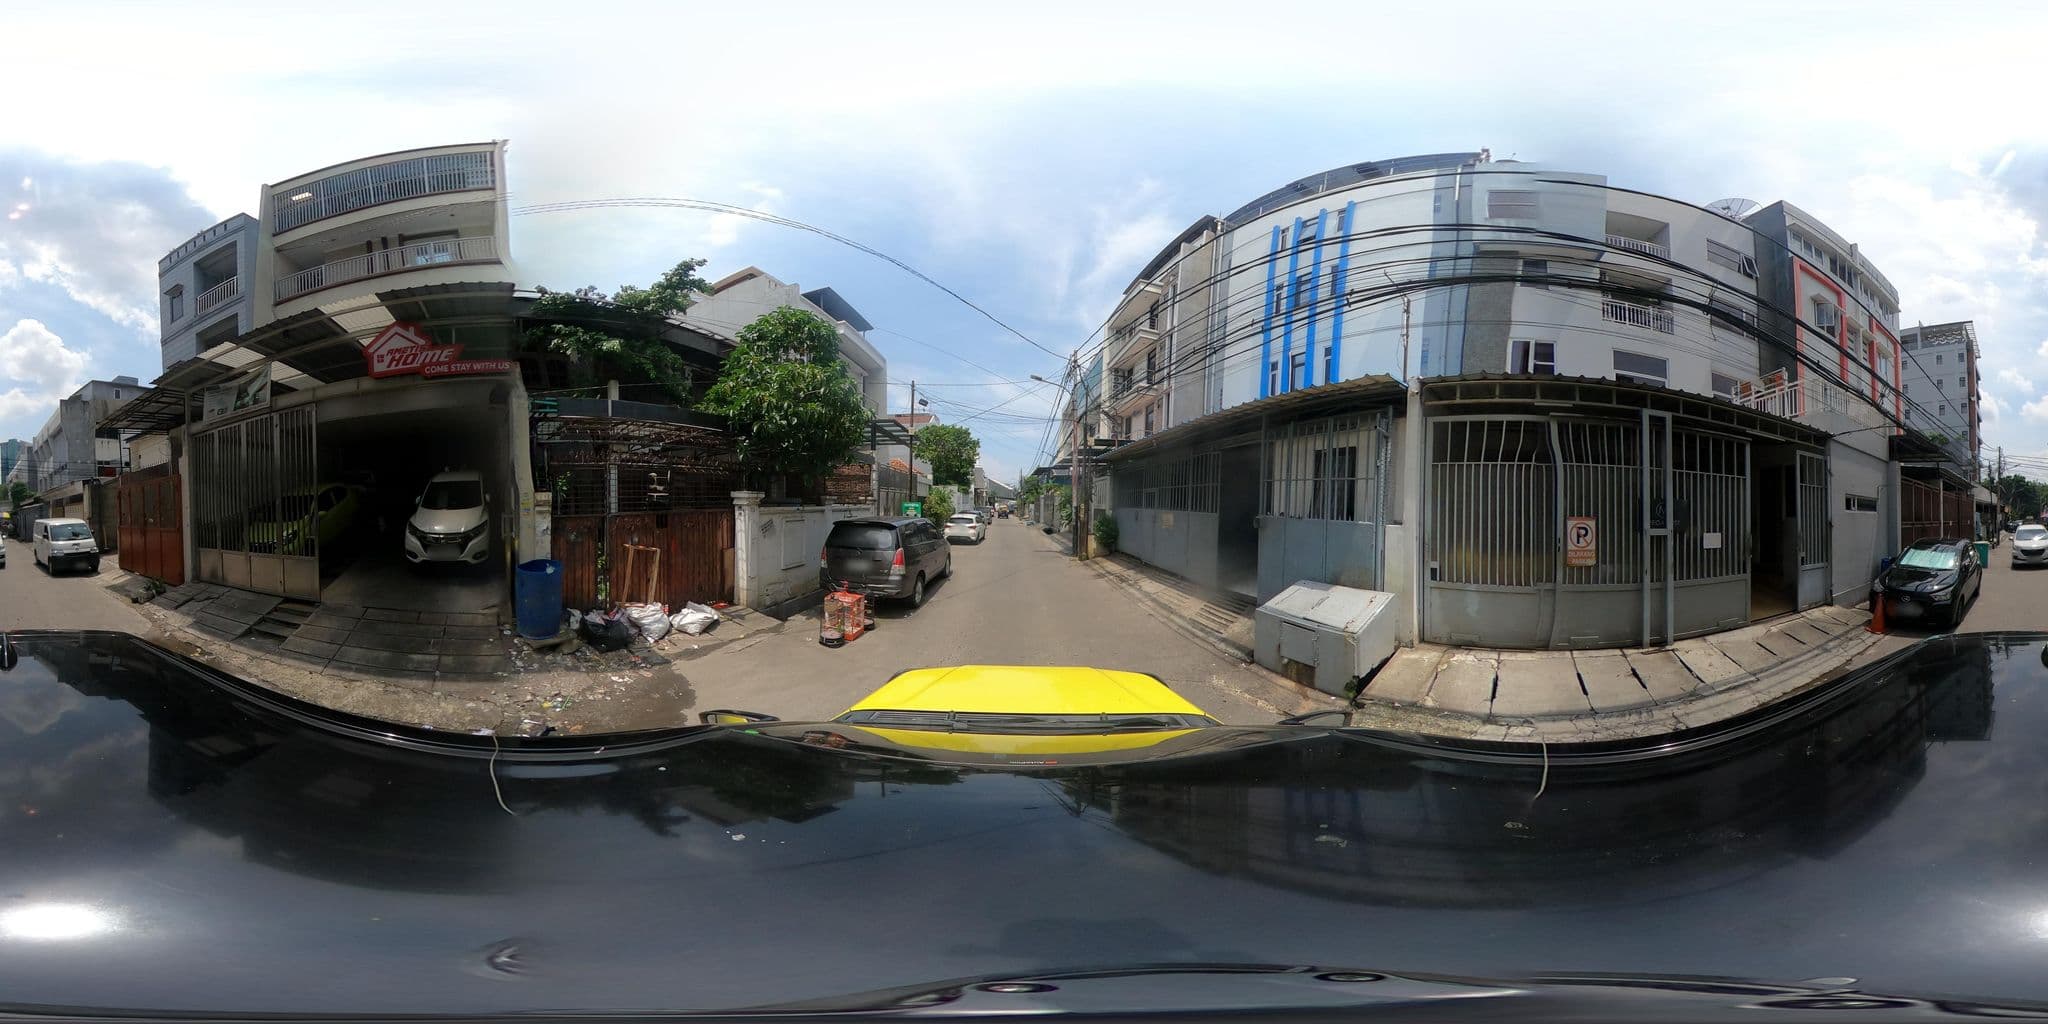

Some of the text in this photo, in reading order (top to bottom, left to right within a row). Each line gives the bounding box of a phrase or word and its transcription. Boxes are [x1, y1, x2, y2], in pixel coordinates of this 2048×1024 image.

[387, 348, 454, 368] HOME
[425, 361, 511, 374] COME STAY WITH US
